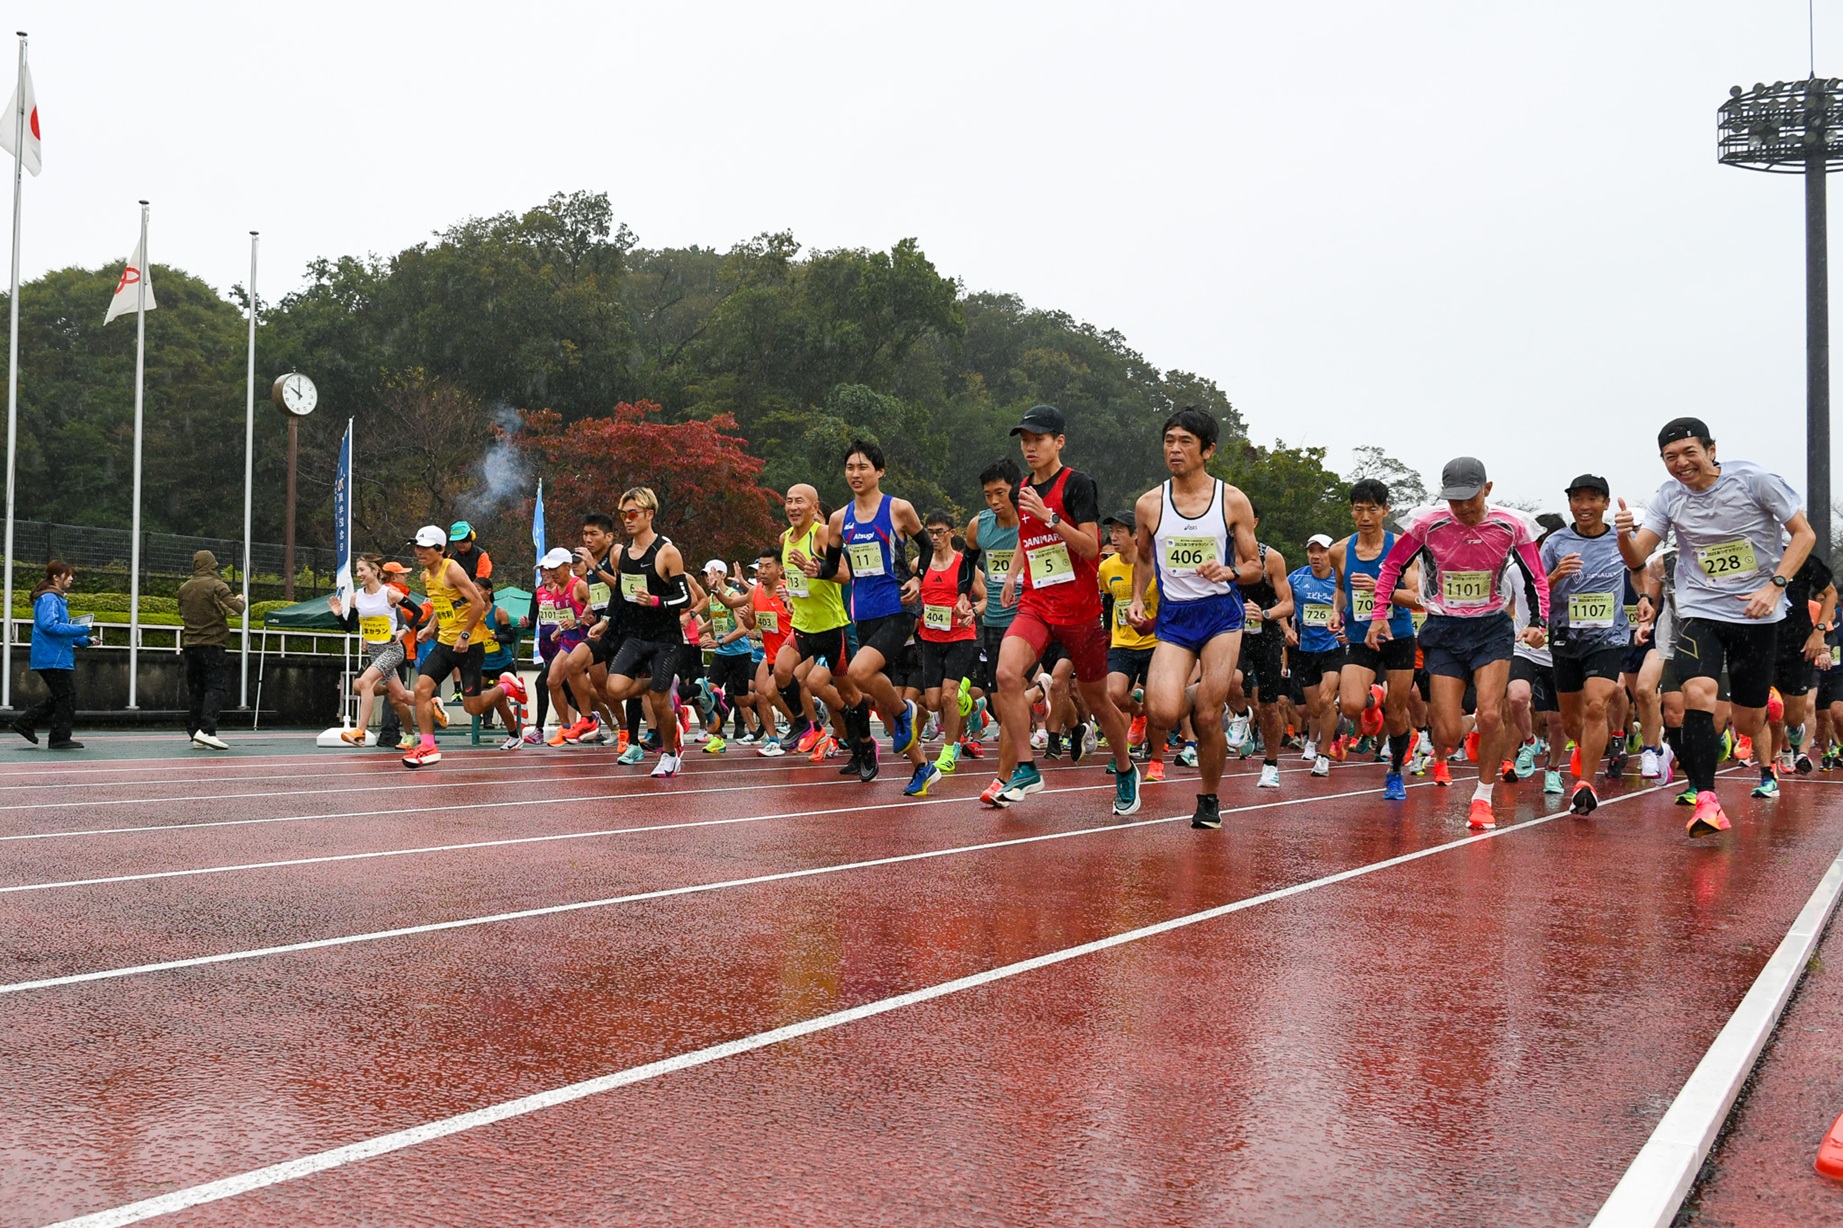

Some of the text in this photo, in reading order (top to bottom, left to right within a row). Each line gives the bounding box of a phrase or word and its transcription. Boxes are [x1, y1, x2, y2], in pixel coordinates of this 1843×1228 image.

[853, 532, 875, 540] Atsugi
[856, 554, 869, 566] 11
[1170, 550, 1203, 564] 406
[1045, 559, 1053, 573] 5
[1705, 555, 1741, 574] 228
[630, 583, 635, 593] 6
[787, 577, 799, 588] 13
[1446, 583, 1480, 596] 1101
[596, 592, 600, 600] 1
[1357, 599, 1376, 611] 70
[1572, 604, 1606, 617] 1107
[540, 611, 556, 619] 2101
[926, 612, 943, 622] 404
[1307, 610, 1326, 619] 726
[758, 618, 771, 627] 403
